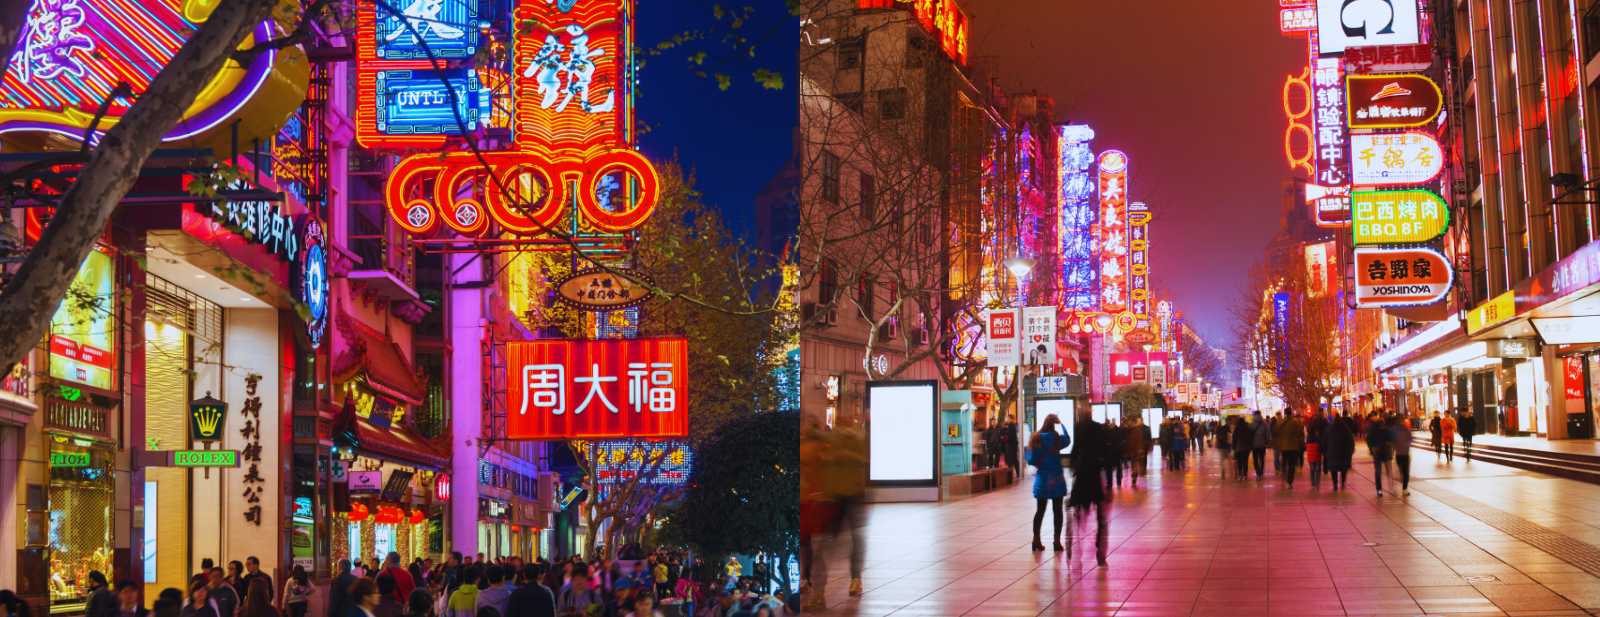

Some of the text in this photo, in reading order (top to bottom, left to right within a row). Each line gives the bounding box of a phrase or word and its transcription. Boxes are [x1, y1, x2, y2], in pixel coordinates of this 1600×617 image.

[1357, 199, 1438, 220] 巴西烤肉
[1360, 223, 1397, 237] BBQ
[1368, 258, 1432, 280] 吉野家
[1373, 285, 1431, 296] YOSHINOYA
[520, 363, 675, 415] 周大福
[179, 453, 230, 464] ROLEX
